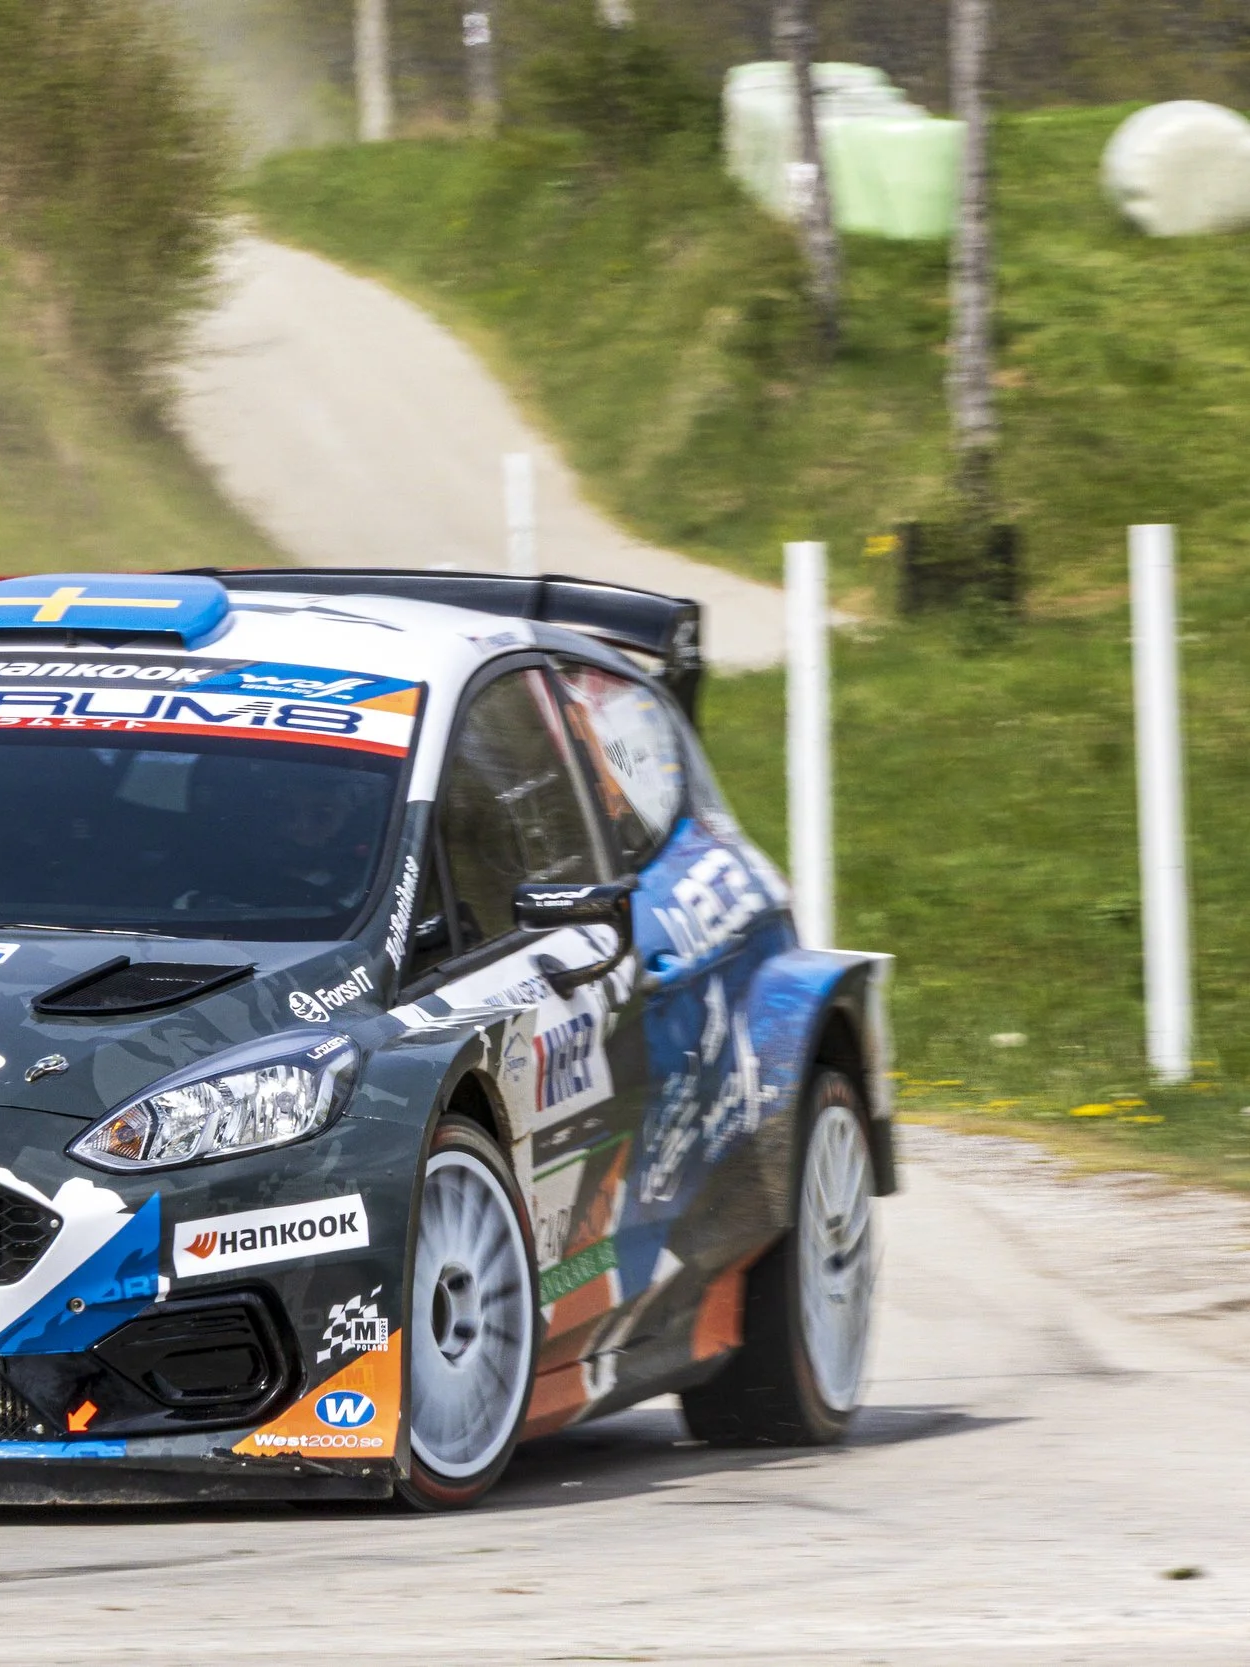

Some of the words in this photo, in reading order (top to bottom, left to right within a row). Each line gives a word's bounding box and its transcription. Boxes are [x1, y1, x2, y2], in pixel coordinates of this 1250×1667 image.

[355, 1321, 376, 1340] M
[356, 1343, 389, 1352] POLAND
[325, 1396, 372, 1423] W
[254, 1434, 384, 1448] West2000.se
